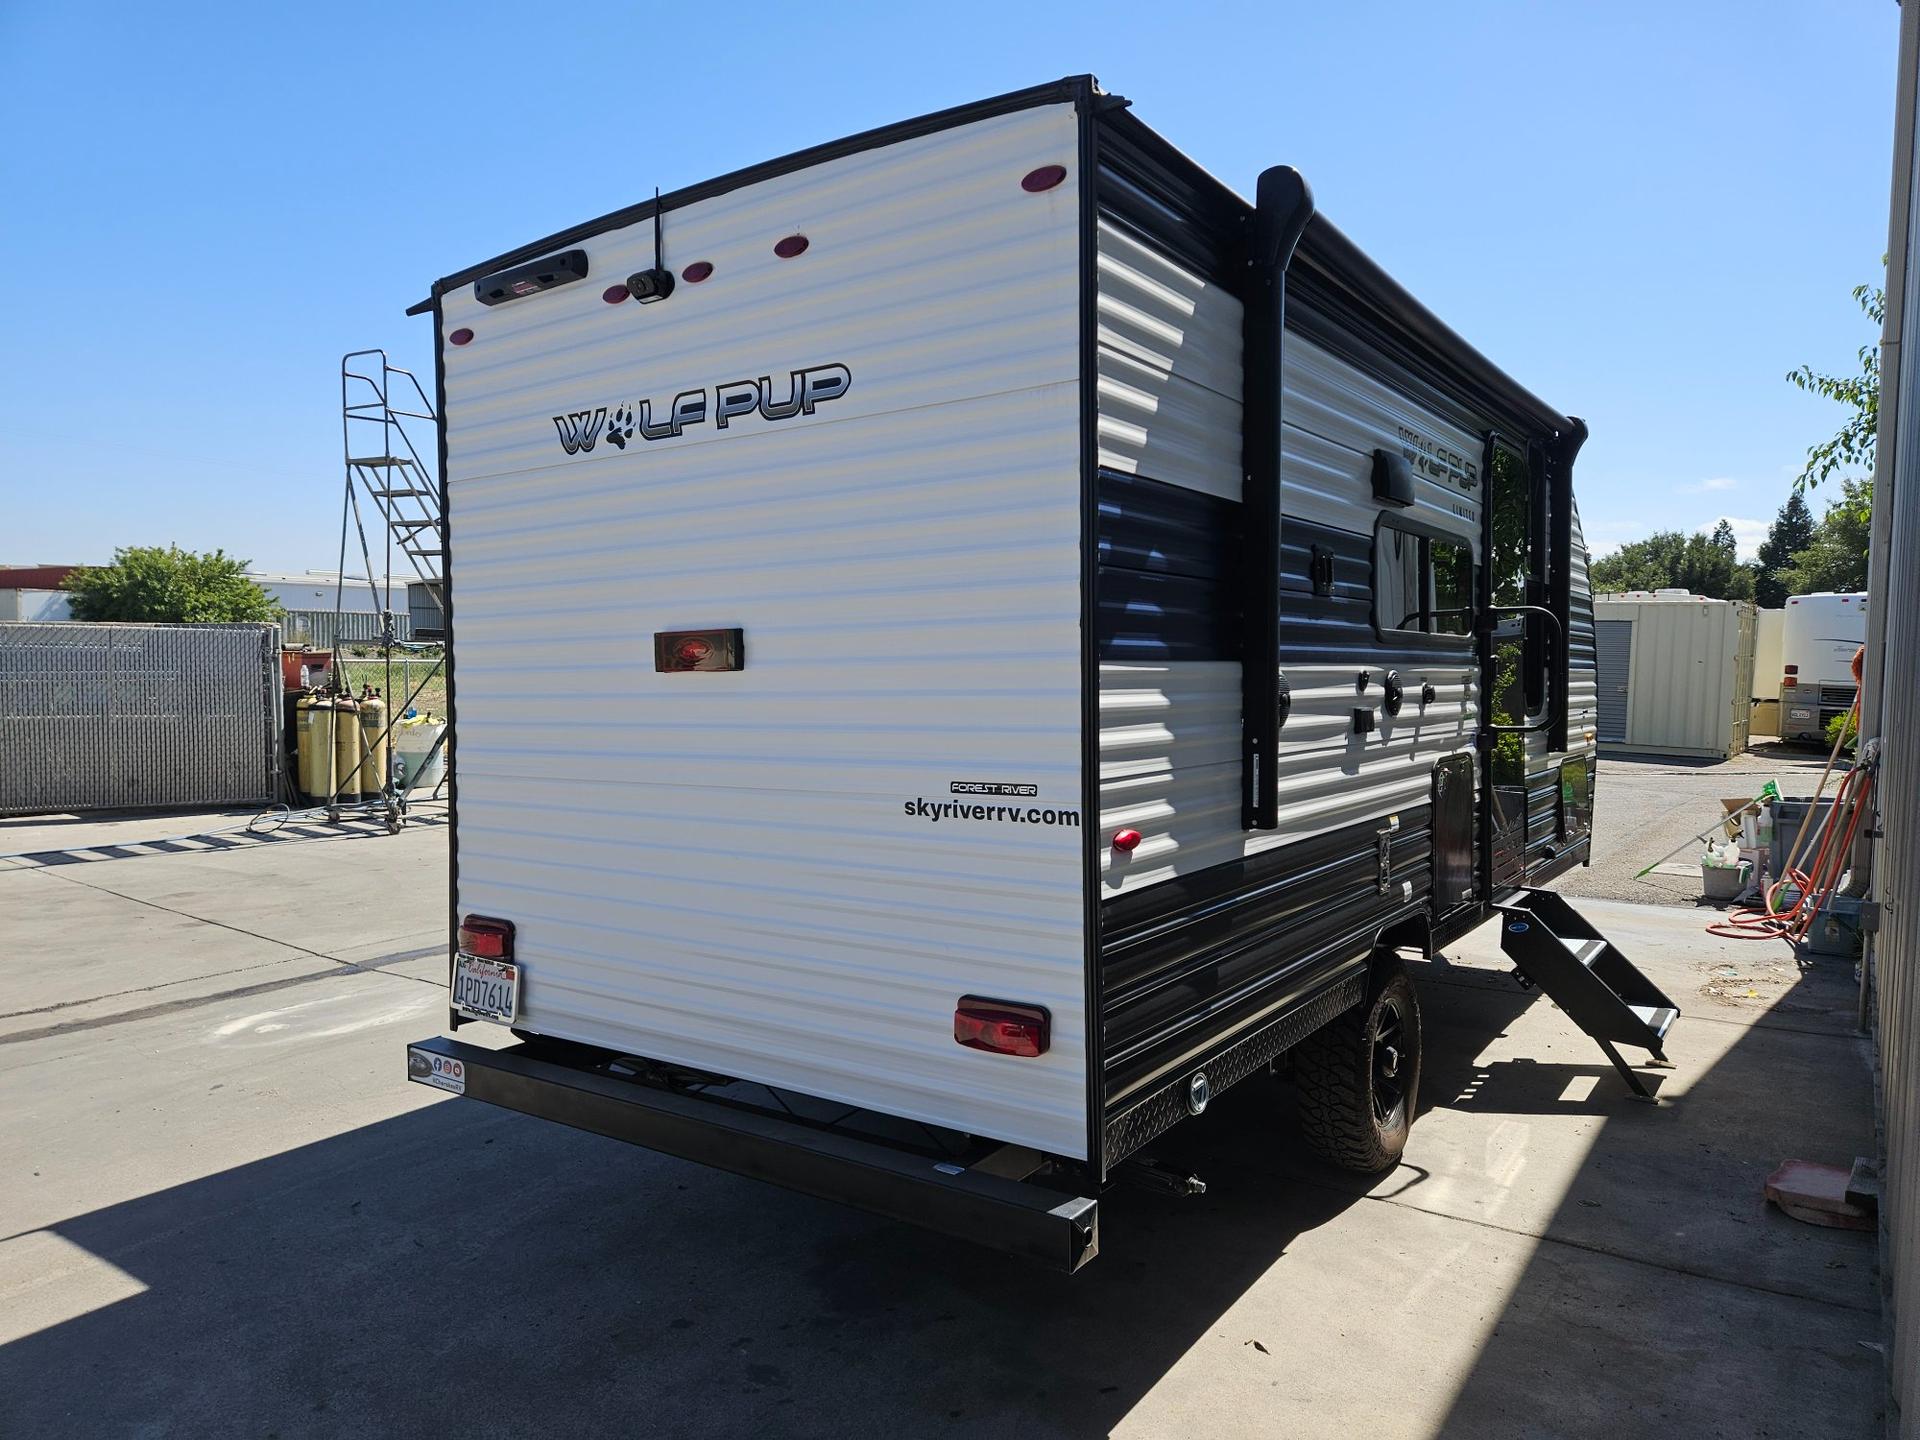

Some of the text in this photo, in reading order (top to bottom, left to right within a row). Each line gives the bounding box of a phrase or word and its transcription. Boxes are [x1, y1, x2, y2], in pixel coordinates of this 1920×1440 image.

[715, 362, 852, 429] PUP
[951, 782, 1037, 796] FOREST RIVER
[904, 798, 1080, 826] skyriverrv.com
[458, 975, 512, 1012] 1PD7614
